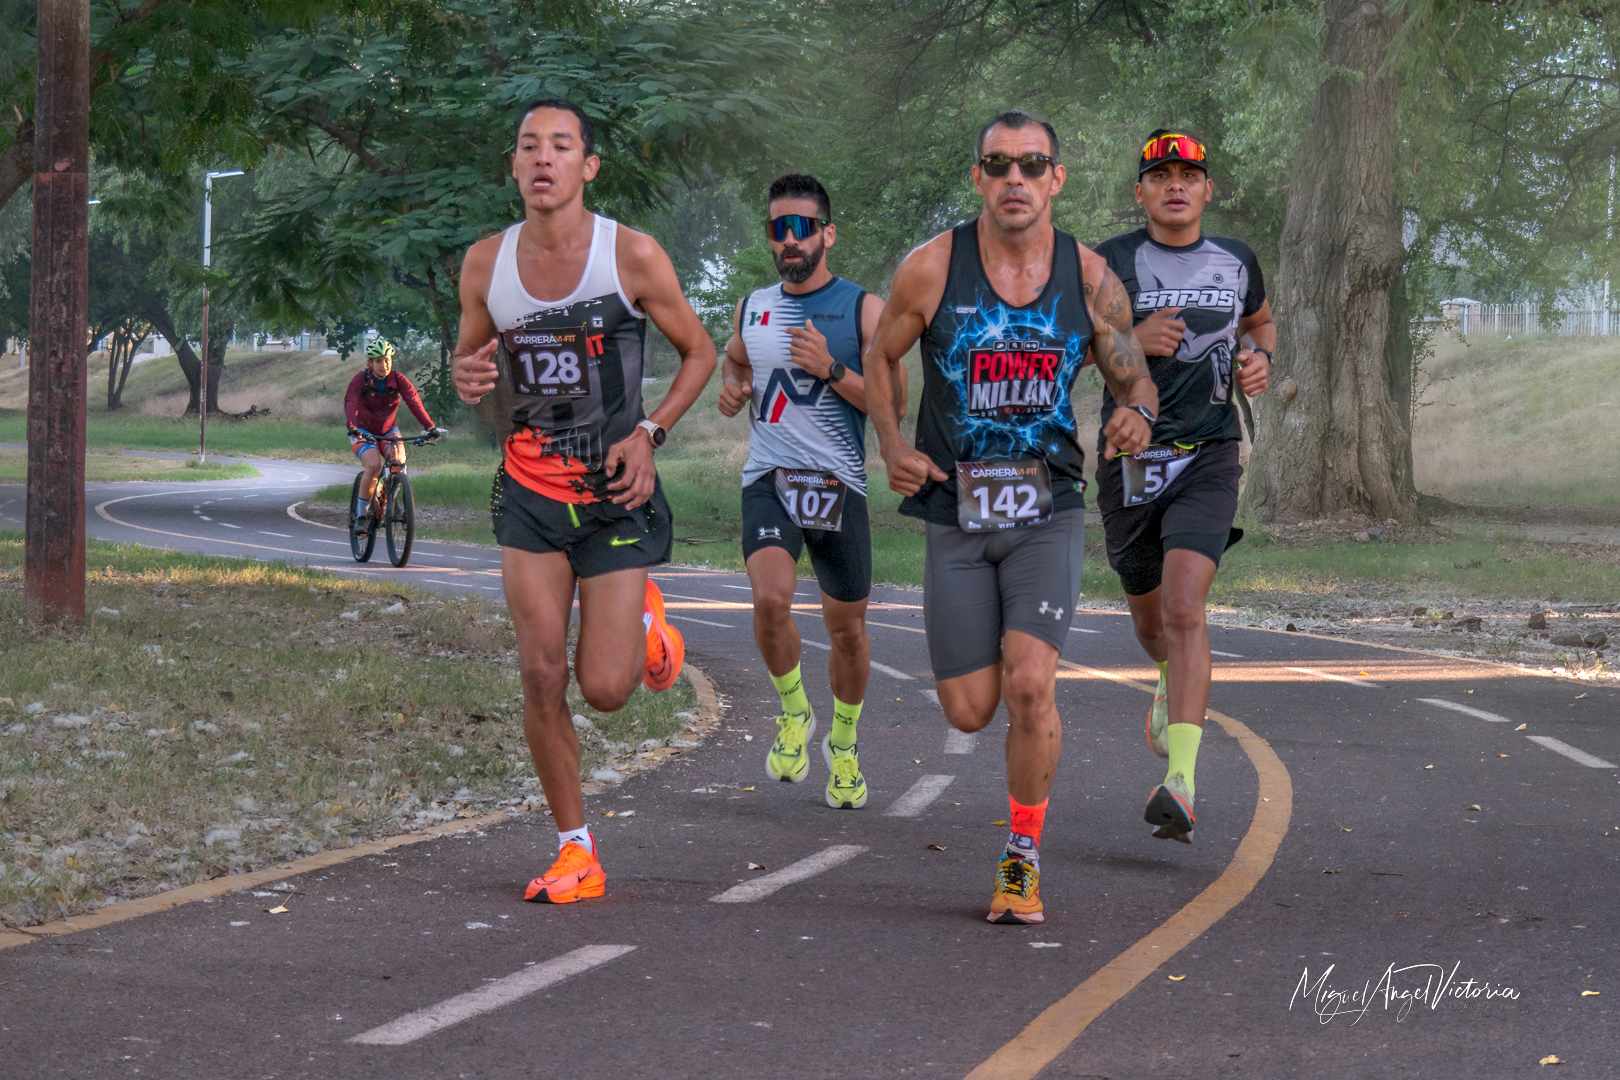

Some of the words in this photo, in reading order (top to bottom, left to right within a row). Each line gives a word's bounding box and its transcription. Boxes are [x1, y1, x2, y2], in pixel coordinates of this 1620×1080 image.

[1135, 289, 1235, 311] SAPOS
[518, 350, 582, 385] 128
[973, 352, 1058, 384] POWER
[787, 475, 824, 485] CARRERA
[971, 467, 1019, 478] CARRERA
[785, 489, 839, 519] 107
[972, 484, 1040, 520] 142
